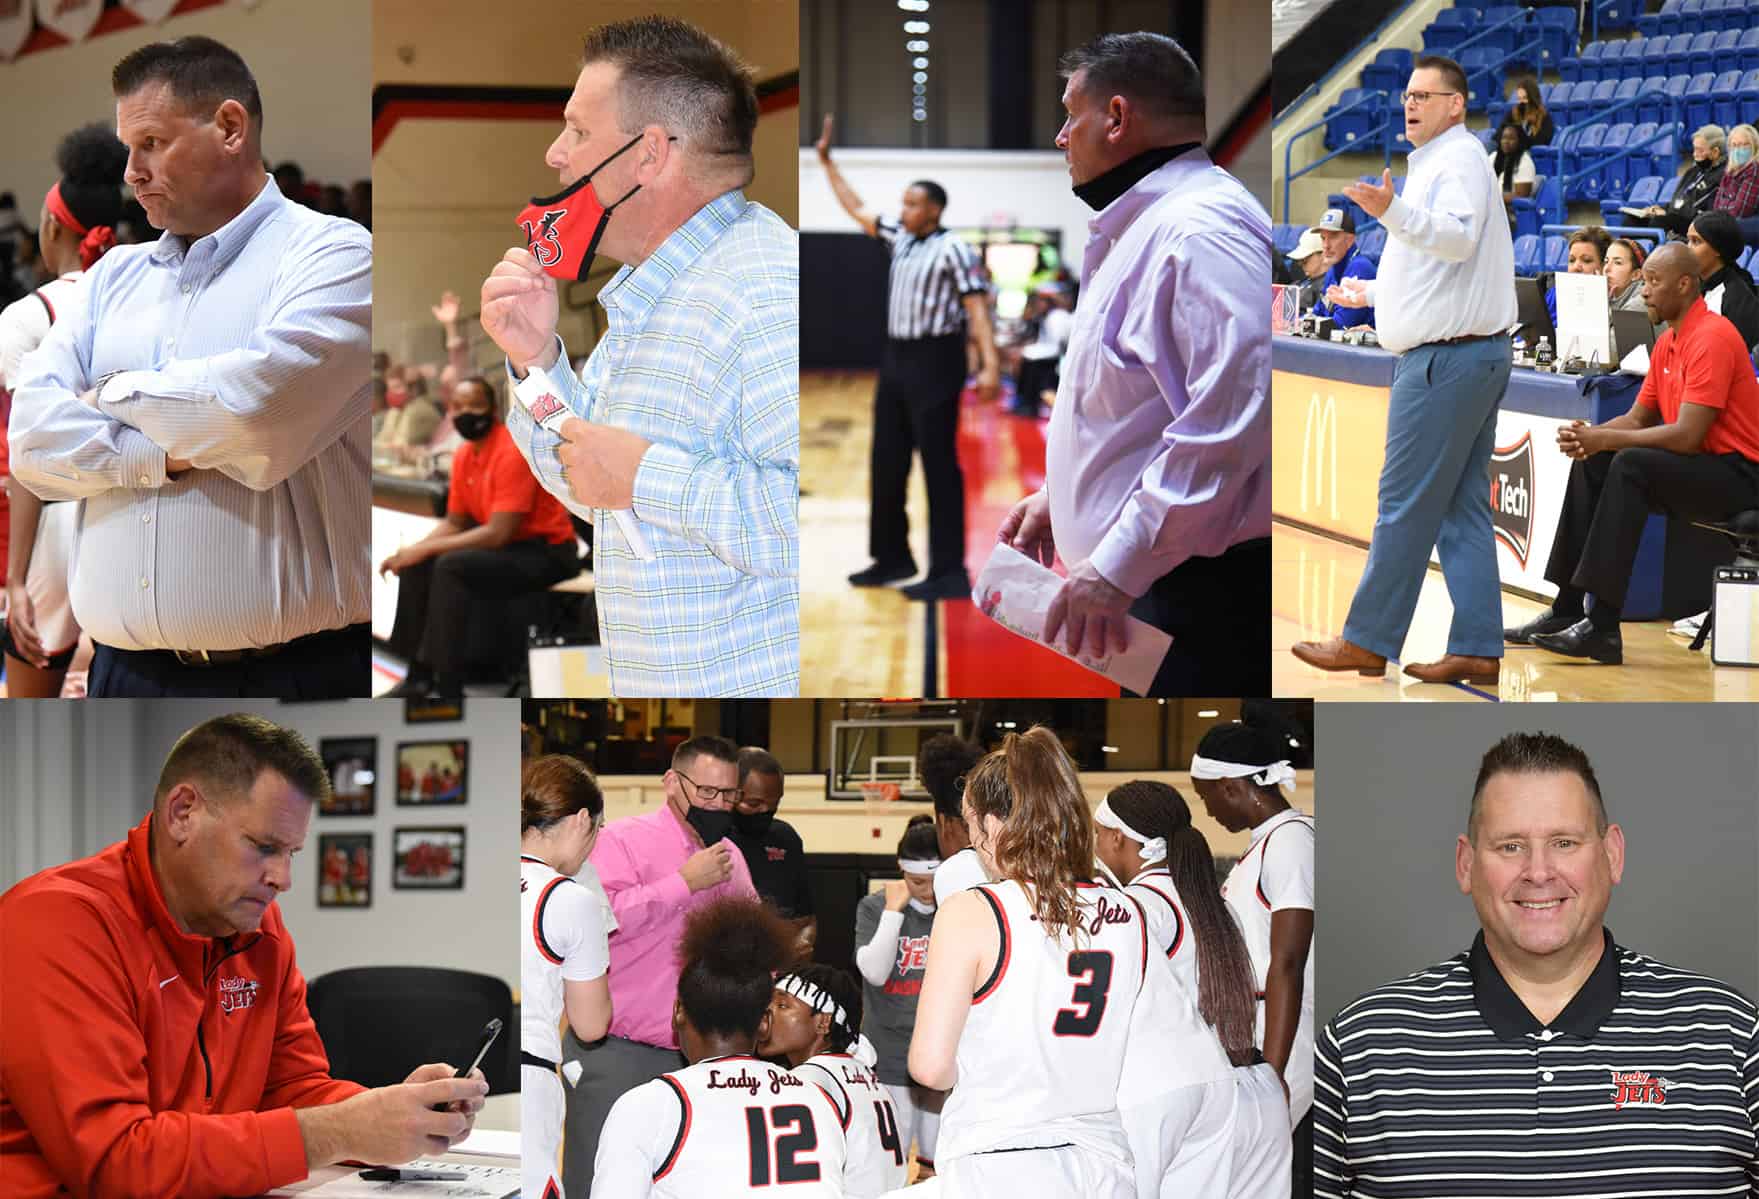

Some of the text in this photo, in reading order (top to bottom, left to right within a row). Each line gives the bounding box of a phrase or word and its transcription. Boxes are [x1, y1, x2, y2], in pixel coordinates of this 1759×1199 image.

[1090, 896, 1131, 935] Jets
[1052, 949, 1114, 1037] 3
[707, 1068, 803, 1096] Lady Jets
[1610, 1083, 1666, 1110] JETS
[1611, 1071, 1649, 1084] Lady
[744, 1103, 821, 1188] 12
[873, 1100, 905, 1167] 4
